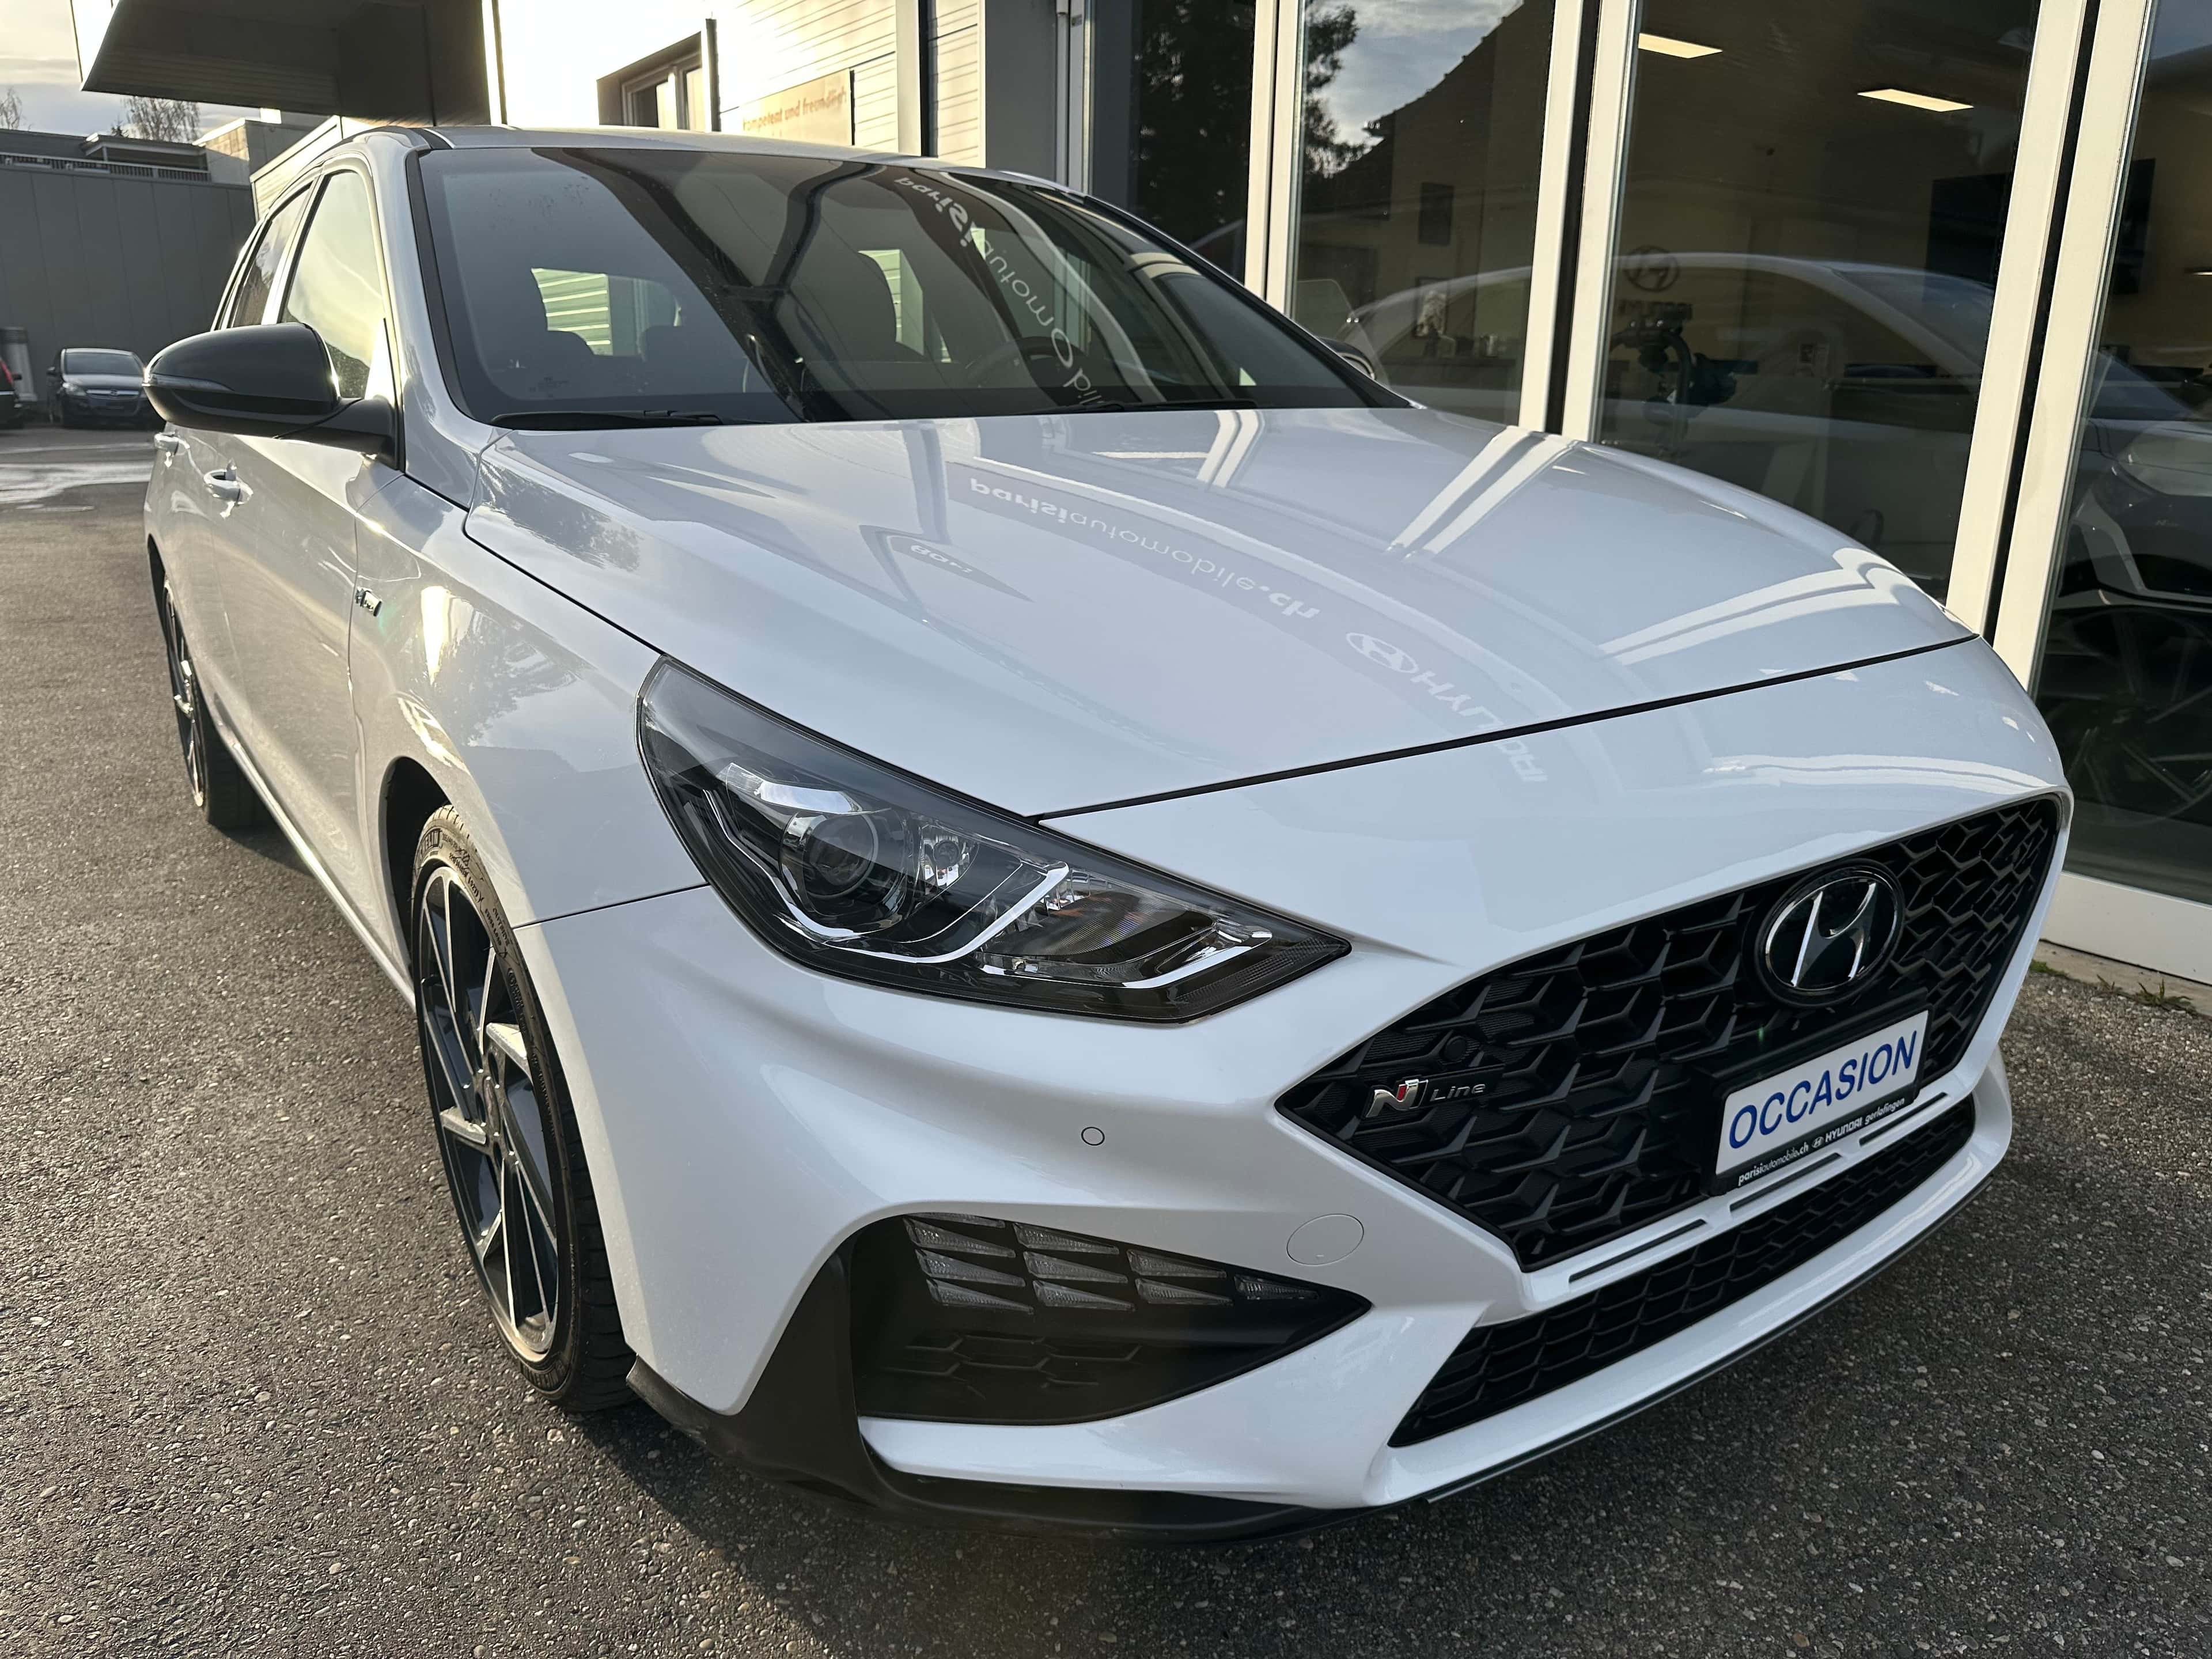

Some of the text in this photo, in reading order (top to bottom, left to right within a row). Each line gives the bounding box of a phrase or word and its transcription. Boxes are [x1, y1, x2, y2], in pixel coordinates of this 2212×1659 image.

[785, 100, 800, 120] und
[1430, 1084, 1486, 1102] Line
[1729, 1030, 1917, 1149] OCCASION
[1737, 1141, 1809, 1186] parisiautomobile.ch
[1825, 1116, 1864, 1143] HYUNDAI
